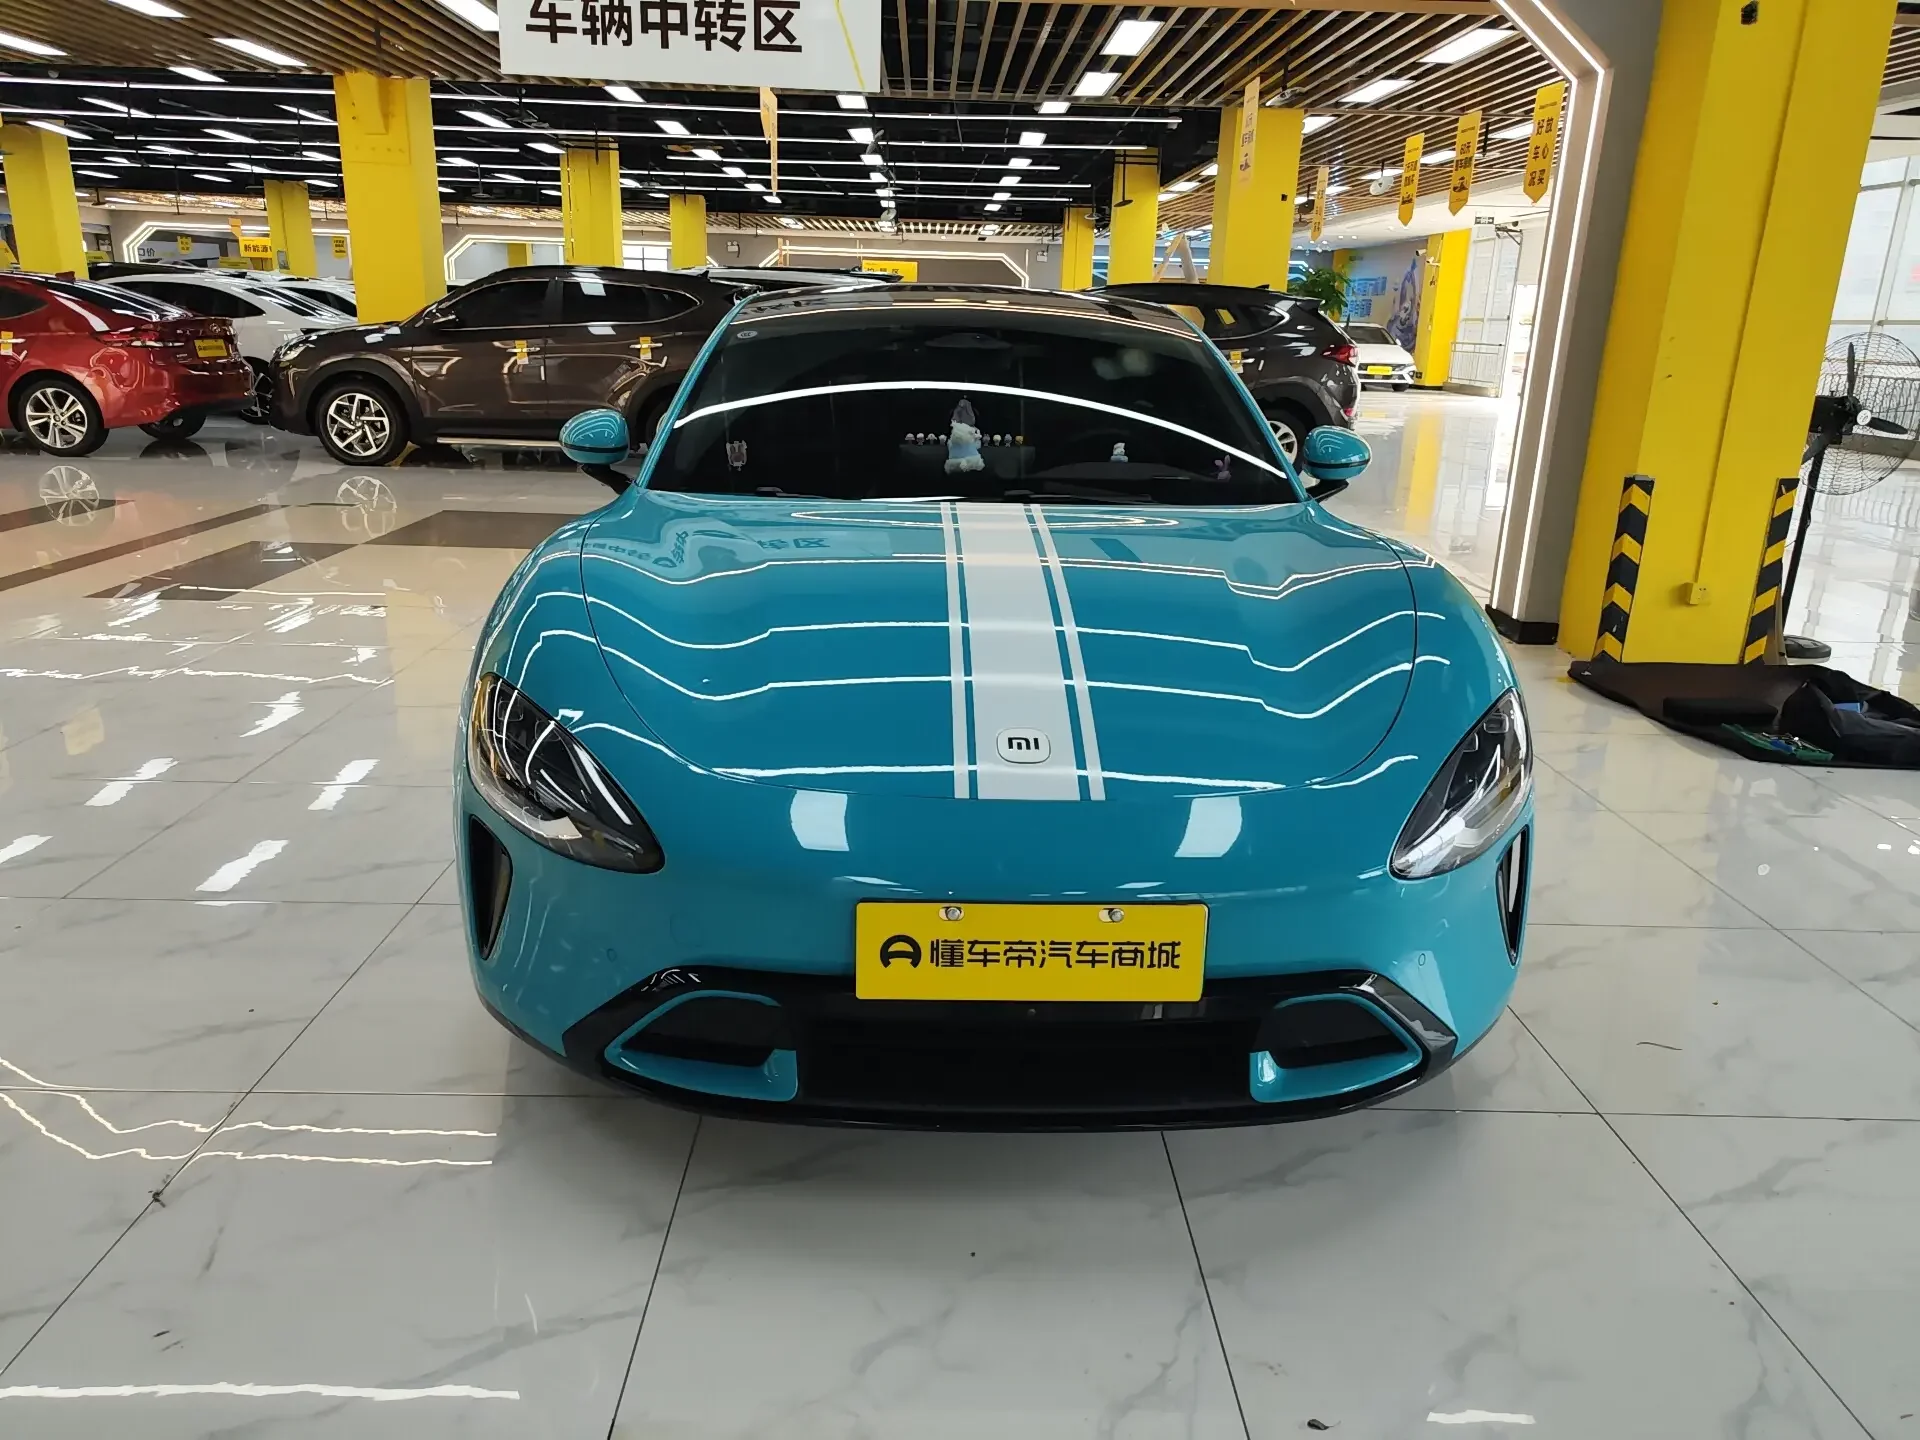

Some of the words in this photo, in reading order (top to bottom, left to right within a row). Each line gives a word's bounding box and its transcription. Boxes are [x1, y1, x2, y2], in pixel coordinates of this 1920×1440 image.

[525, 0, 803, 53] 车辆中转区
[929, 938, 1182, 969] 懂车帝汽车商城
